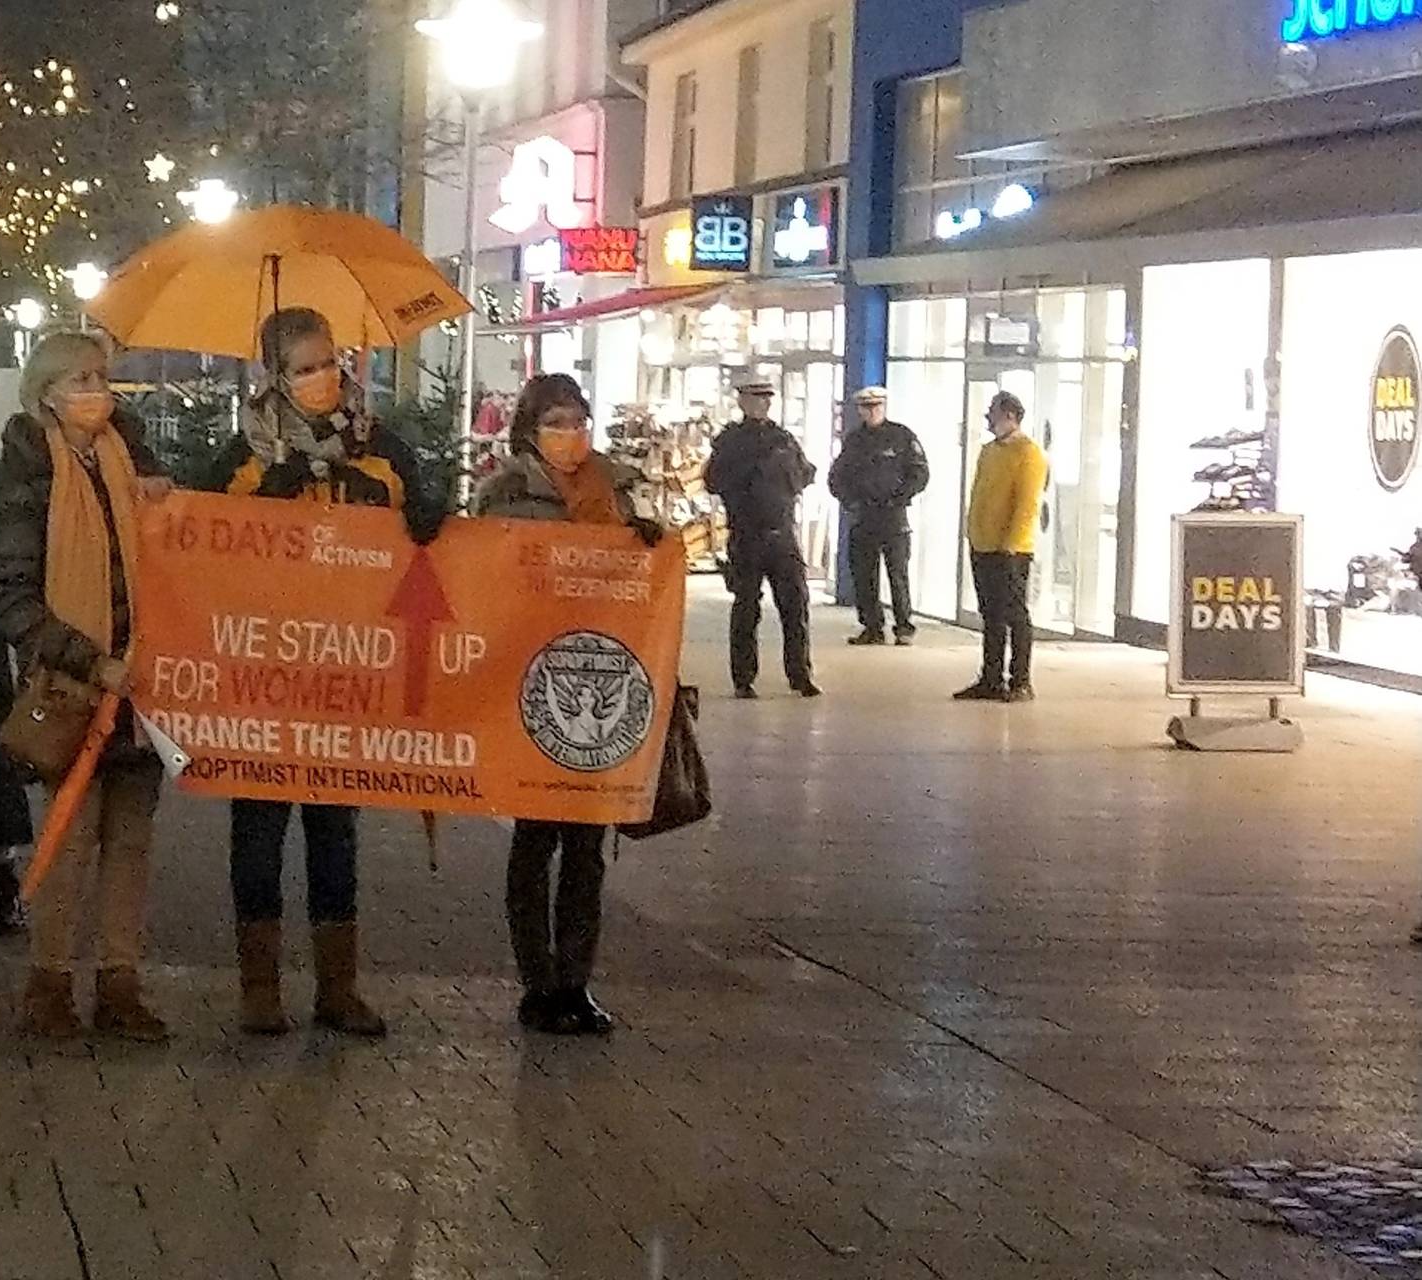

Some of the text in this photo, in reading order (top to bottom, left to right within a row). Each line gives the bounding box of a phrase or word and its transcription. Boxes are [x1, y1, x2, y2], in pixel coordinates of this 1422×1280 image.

[1376, 376, 1415, 408] DEAL
[1375, 410, 1415, 442] DAYS
[164, 512, 306, 560] 16 DAYS
[312, 523, 337, 543] OF
[310, 545, 393, 568] ACTIVISM
[551, 545, 652, 575] NOVEMBER
[1192, 576, 1282, 602] DEAL
[1190, 603, 1283, 631] DAYS
[211, 614, 487, 675] WE STAND UP
[152, 655, 387, 715] FOR WOMEN!
[289, 719, 352, 760] THE
[360, 726, 477, 767] WORLD
[306, 765, 484, 800] INTERNATIONAL
